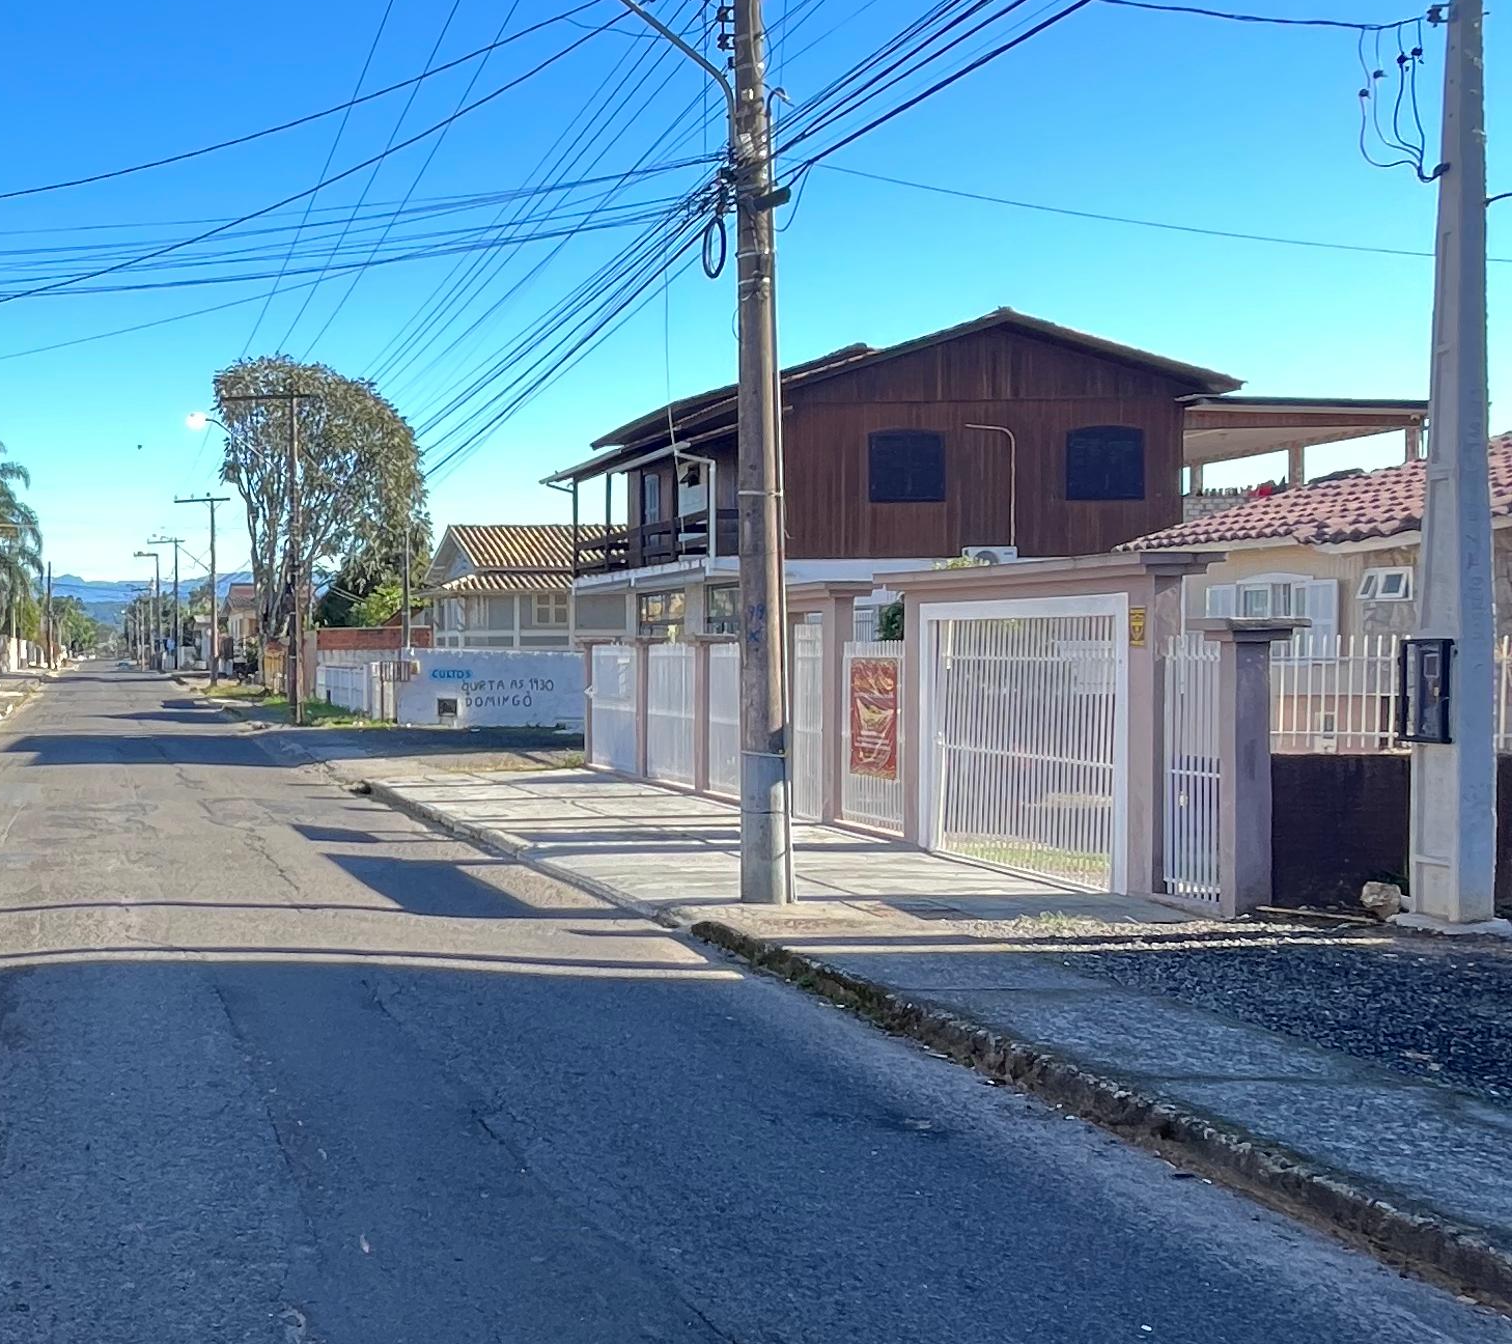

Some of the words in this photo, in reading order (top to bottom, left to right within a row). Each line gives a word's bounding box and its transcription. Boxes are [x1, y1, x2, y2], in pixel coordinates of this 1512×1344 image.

[431, 669, 472, 679] CULTOS
[529, 679, 554, 692] 1930
[465, 693, 532, 707] DOMINGO
